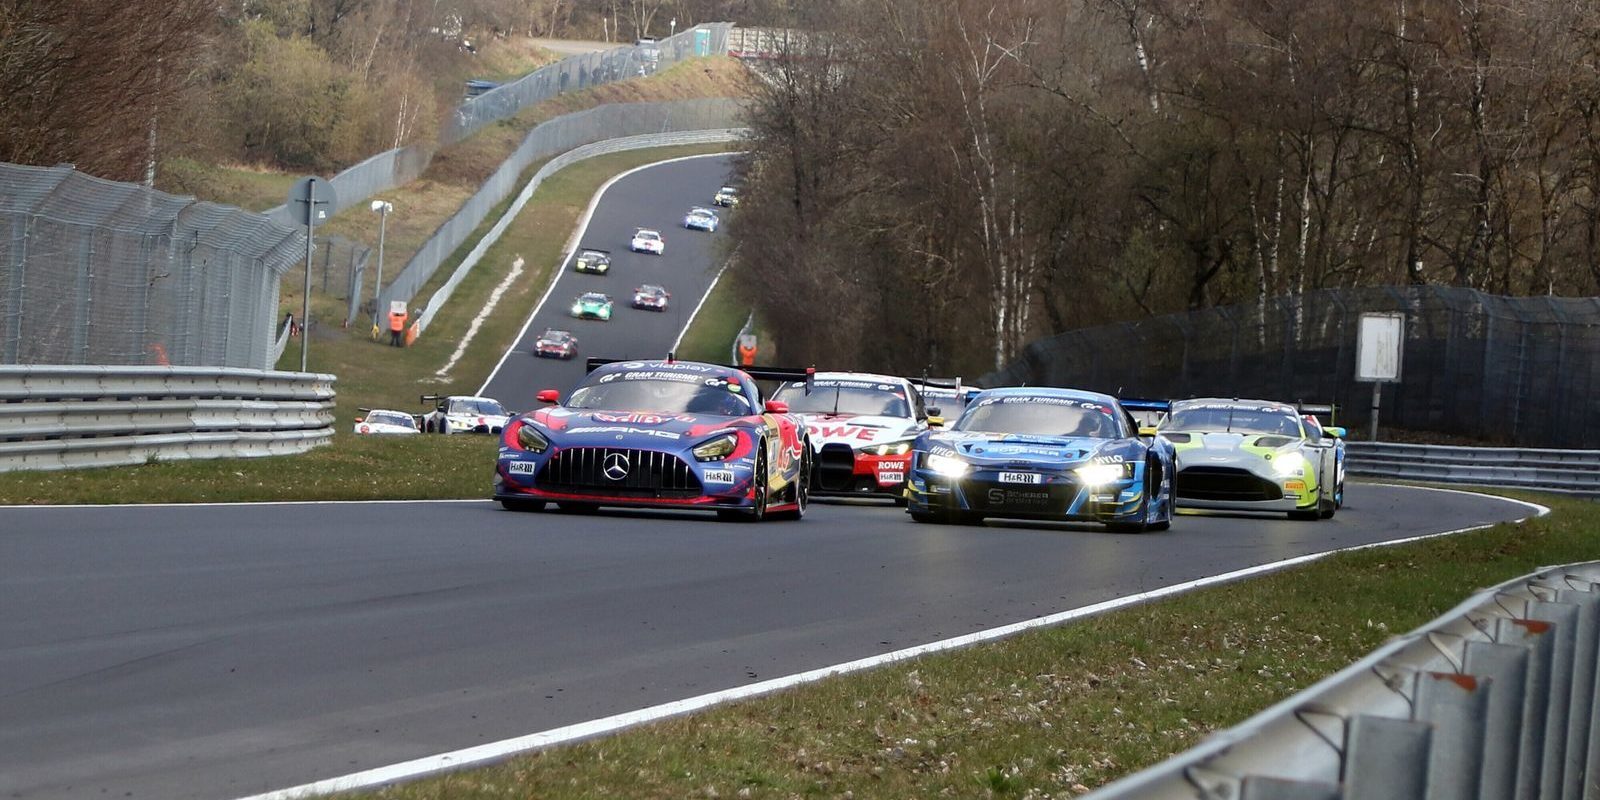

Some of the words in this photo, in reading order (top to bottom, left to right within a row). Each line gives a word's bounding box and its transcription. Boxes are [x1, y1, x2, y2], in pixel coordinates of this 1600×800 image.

[625, 371, 653, 379] GRAN
[654, 372, 699, 381] TURISMO
[1032, 397, 1074, 406] TURISMO
[930, 446, 954, 457] HYLO
[1094, 454, 1123, 464] HYLO
[878, 461, 904, 470] ROWE
